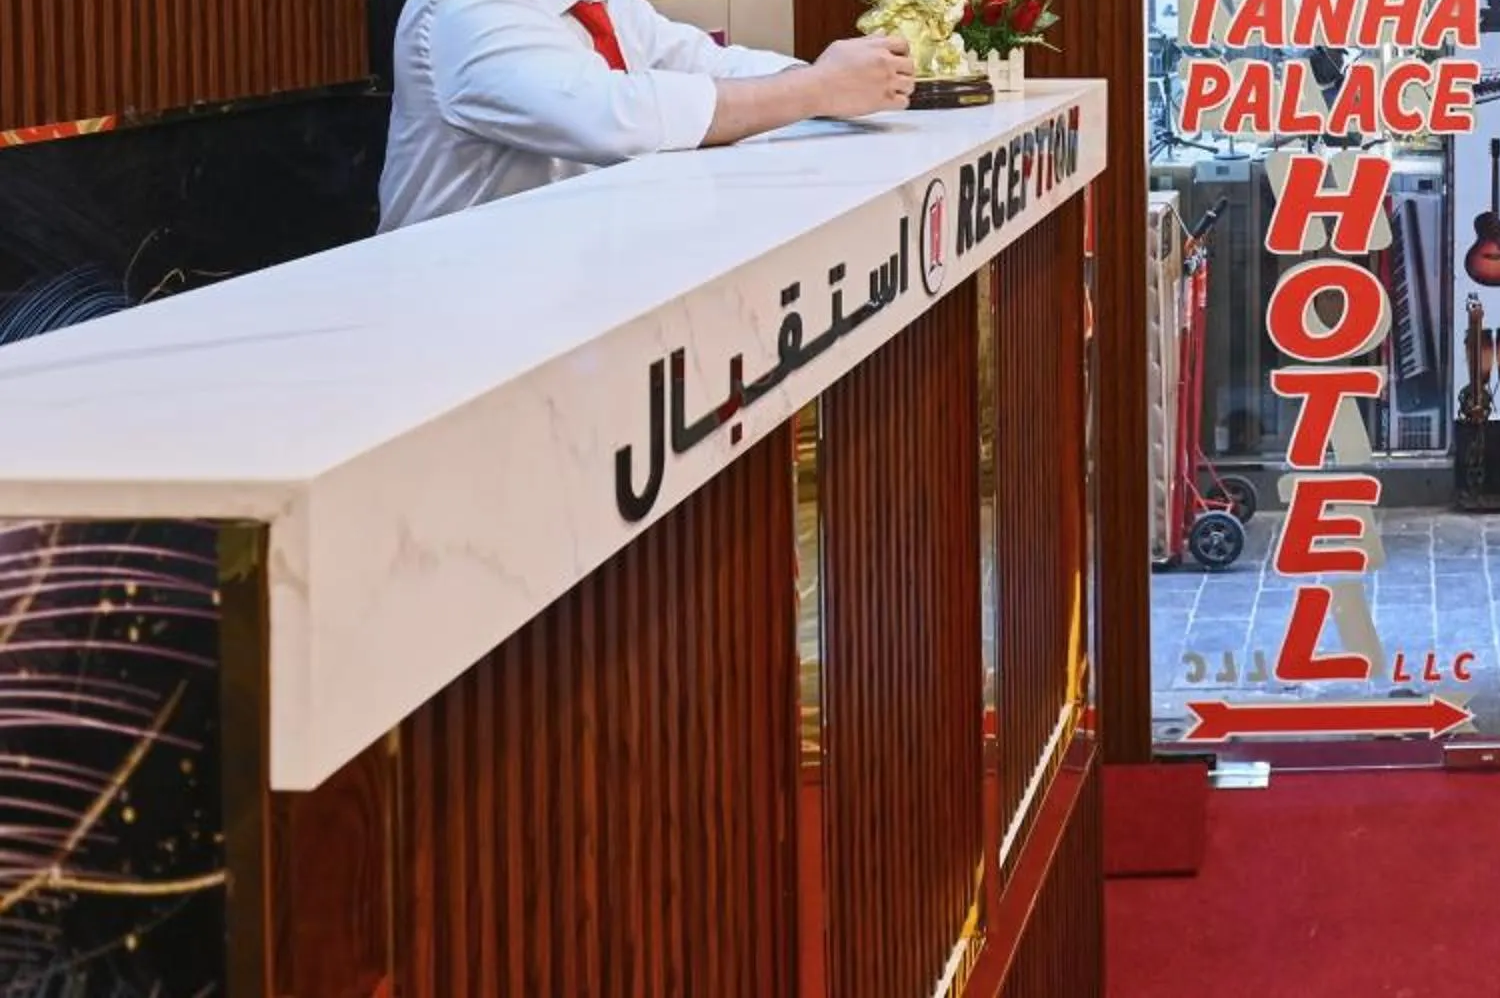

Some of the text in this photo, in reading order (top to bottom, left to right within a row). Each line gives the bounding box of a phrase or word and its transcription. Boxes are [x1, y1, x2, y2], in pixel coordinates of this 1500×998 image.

[1178, 59, 1480, 134] PALACE
[956, 105, 1080, 258] RECEPTION
[615, 216, 909, 522] استقبال
[1265, 153, 1393, 682] HOTEL
[1391, 652, 1476, 683] LLC
